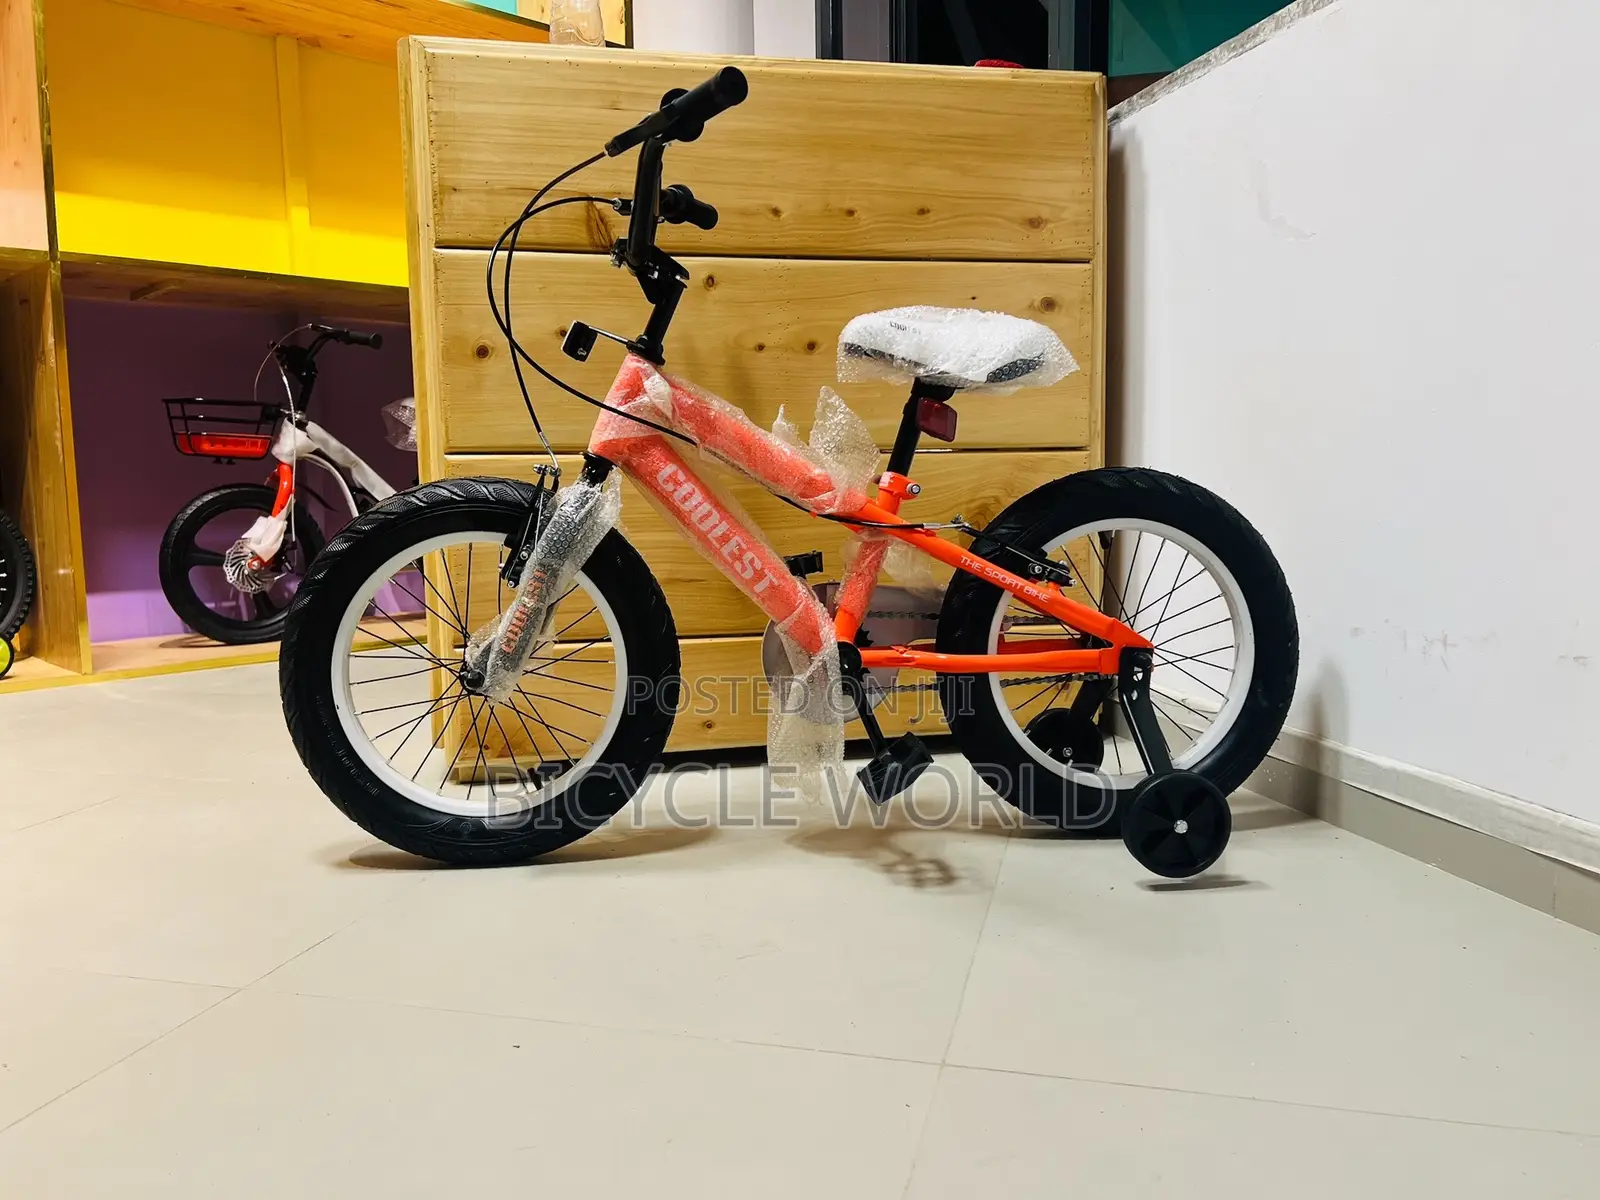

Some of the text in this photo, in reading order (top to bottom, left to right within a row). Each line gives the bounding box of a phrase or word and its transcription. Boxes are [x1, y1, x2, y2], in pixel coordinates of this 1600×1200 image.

[656, 463, 779, 593] COOLEST
[960, 555, 1052, 603] THE SPORT BIKE
